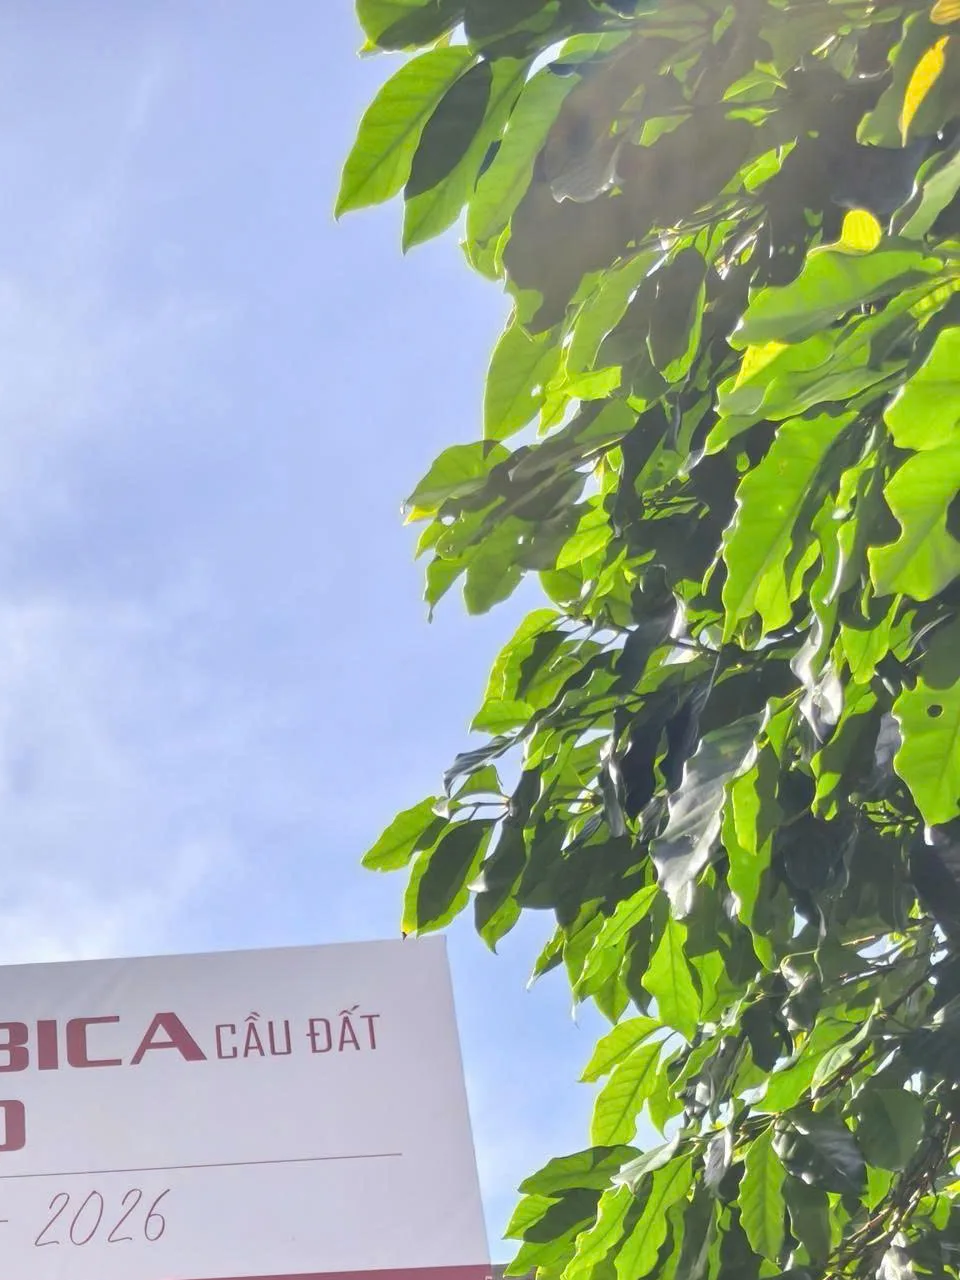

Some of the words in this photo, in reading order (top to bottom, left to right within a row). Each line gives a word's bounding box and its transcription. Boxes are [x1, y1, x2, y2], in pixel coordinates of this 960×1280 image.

[215, 1011, 292, 1060] CẦU
[306, 1004, 381, 1054] ĐẤT
[33, 1188, 172, 1247] 2026
